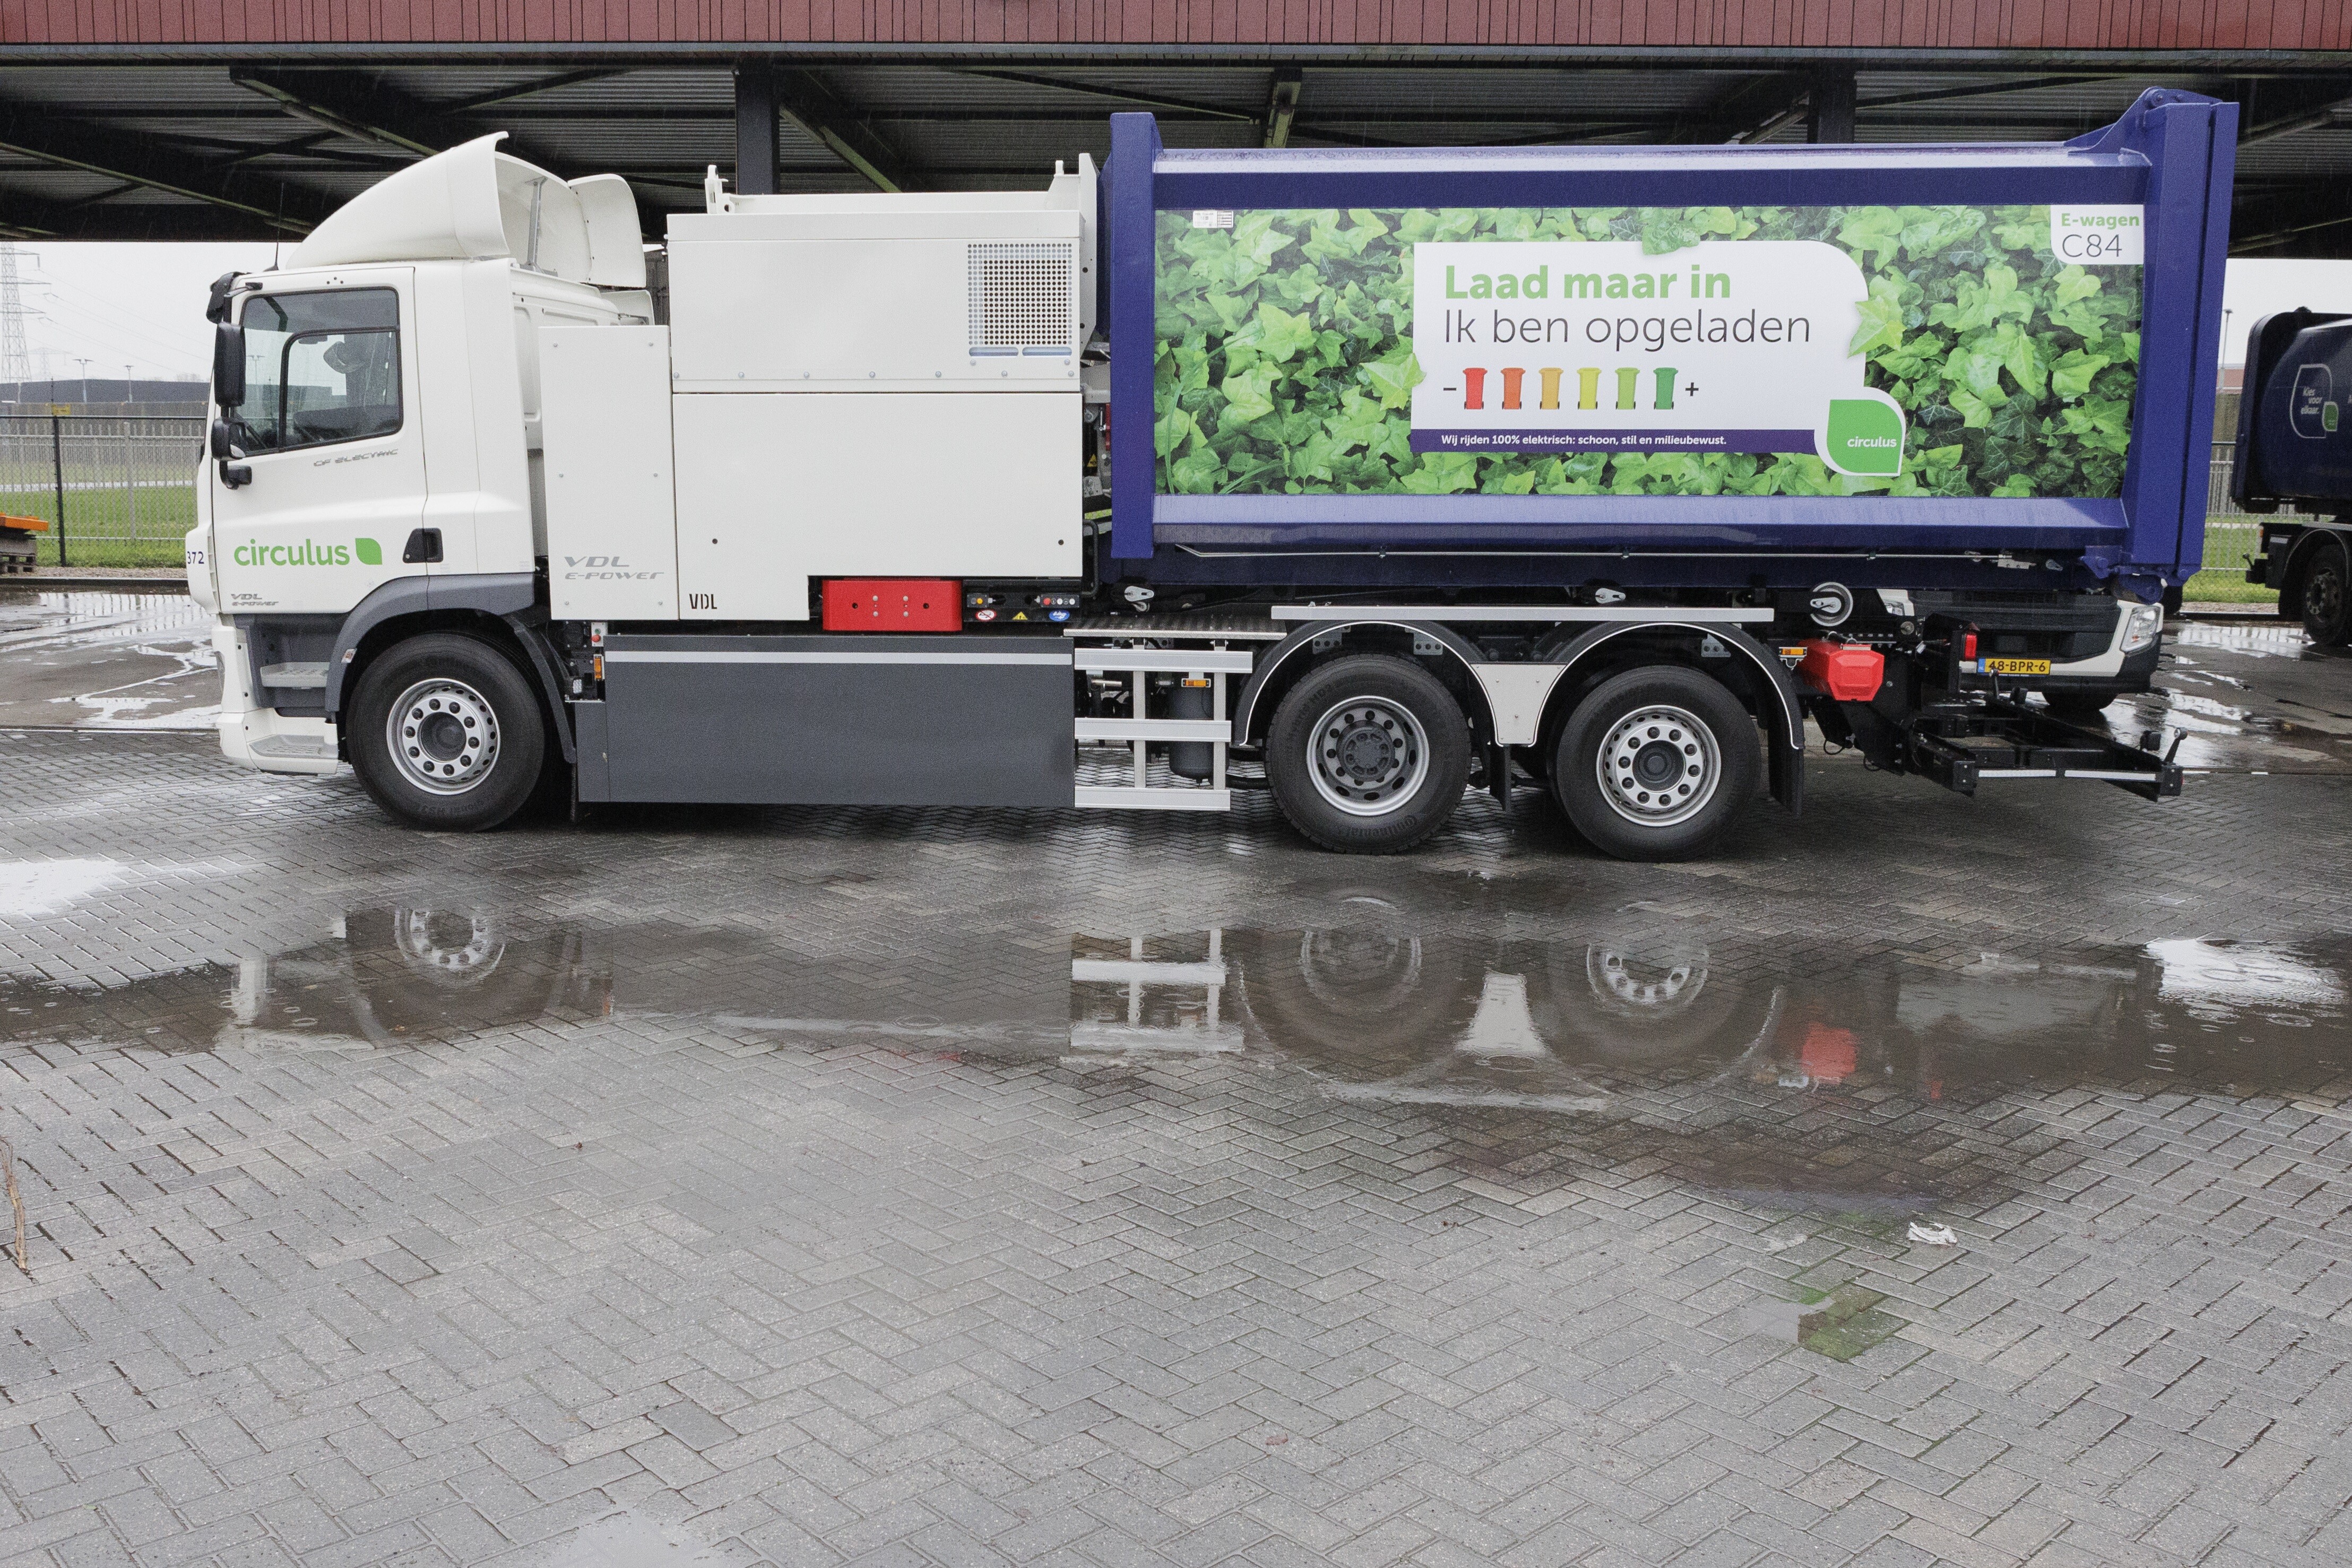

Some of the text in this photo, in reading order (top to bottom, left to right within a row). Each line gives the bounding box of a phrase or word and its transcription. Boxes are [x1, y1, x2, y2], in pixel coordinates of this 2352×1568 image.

[2061, 213, 2140, 230] E-wagen
[2062, 233, 2123, 258] C84
[1446, 264, 1731, 299] Laad maar in
[1446, 308, 1810, 352] Ik ben opgeladen
[1441, 435, 1458, 446] Wij
[1460, 435, 1490, 446] rijden
[1492, 435, 1520, 444] 100%
[1522, 435, 1576, 444] elektrisch:
[1578, 435, 1619, 445] schoon,
[1621, 435, 1637, 445] stil
[1655, 435, 1726, 445] milieubewust.
[1847, 436, 1897, 447] circulus
[187, 551, 204, 564] 372
[234, 539, 350, 566] circulus
[564, 556, 629, 567] VDL
[689, 593, 717, 610] VDL
[1989, 661, 2046, 672] 48-BPR-6
